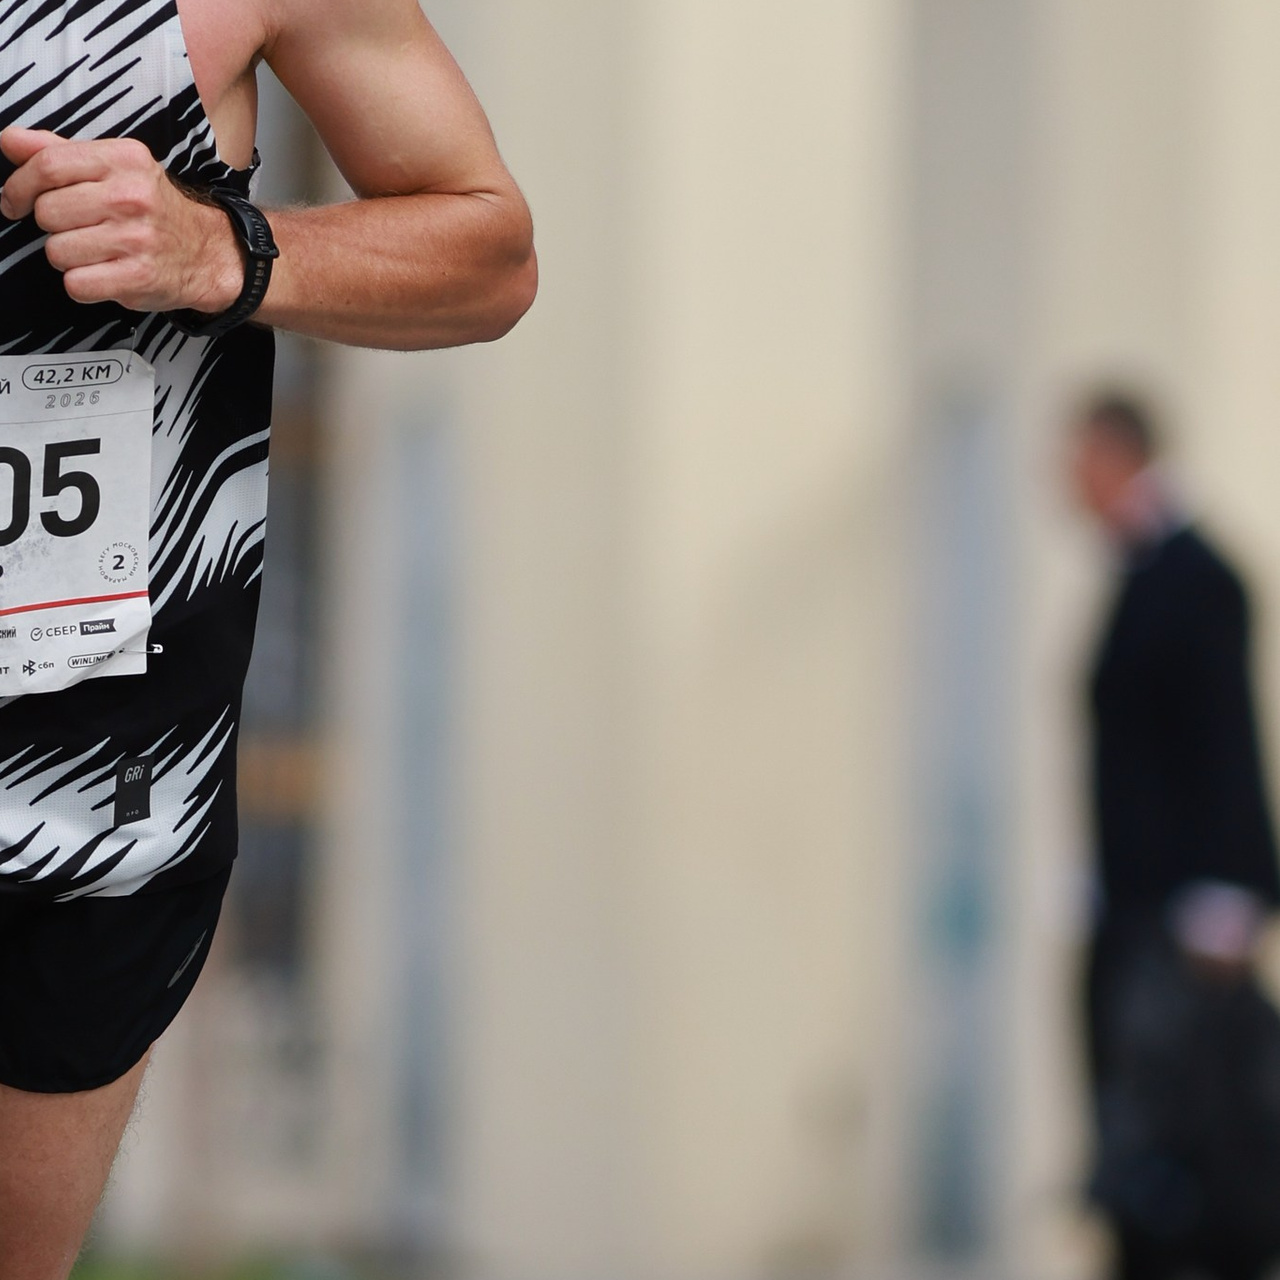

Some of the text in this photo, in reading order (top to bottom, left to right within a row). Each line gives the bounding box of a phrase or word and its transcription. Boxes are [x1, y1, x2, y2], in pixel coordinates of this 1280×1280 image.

[33, 368, 75, 385] 42,2
[44, 390, 101, 409] 2026
[112, 554, 125, 570] 2
[45, 623, 110, 637] СБЕР Прайм
[37, 662, 55, 670] сбп
